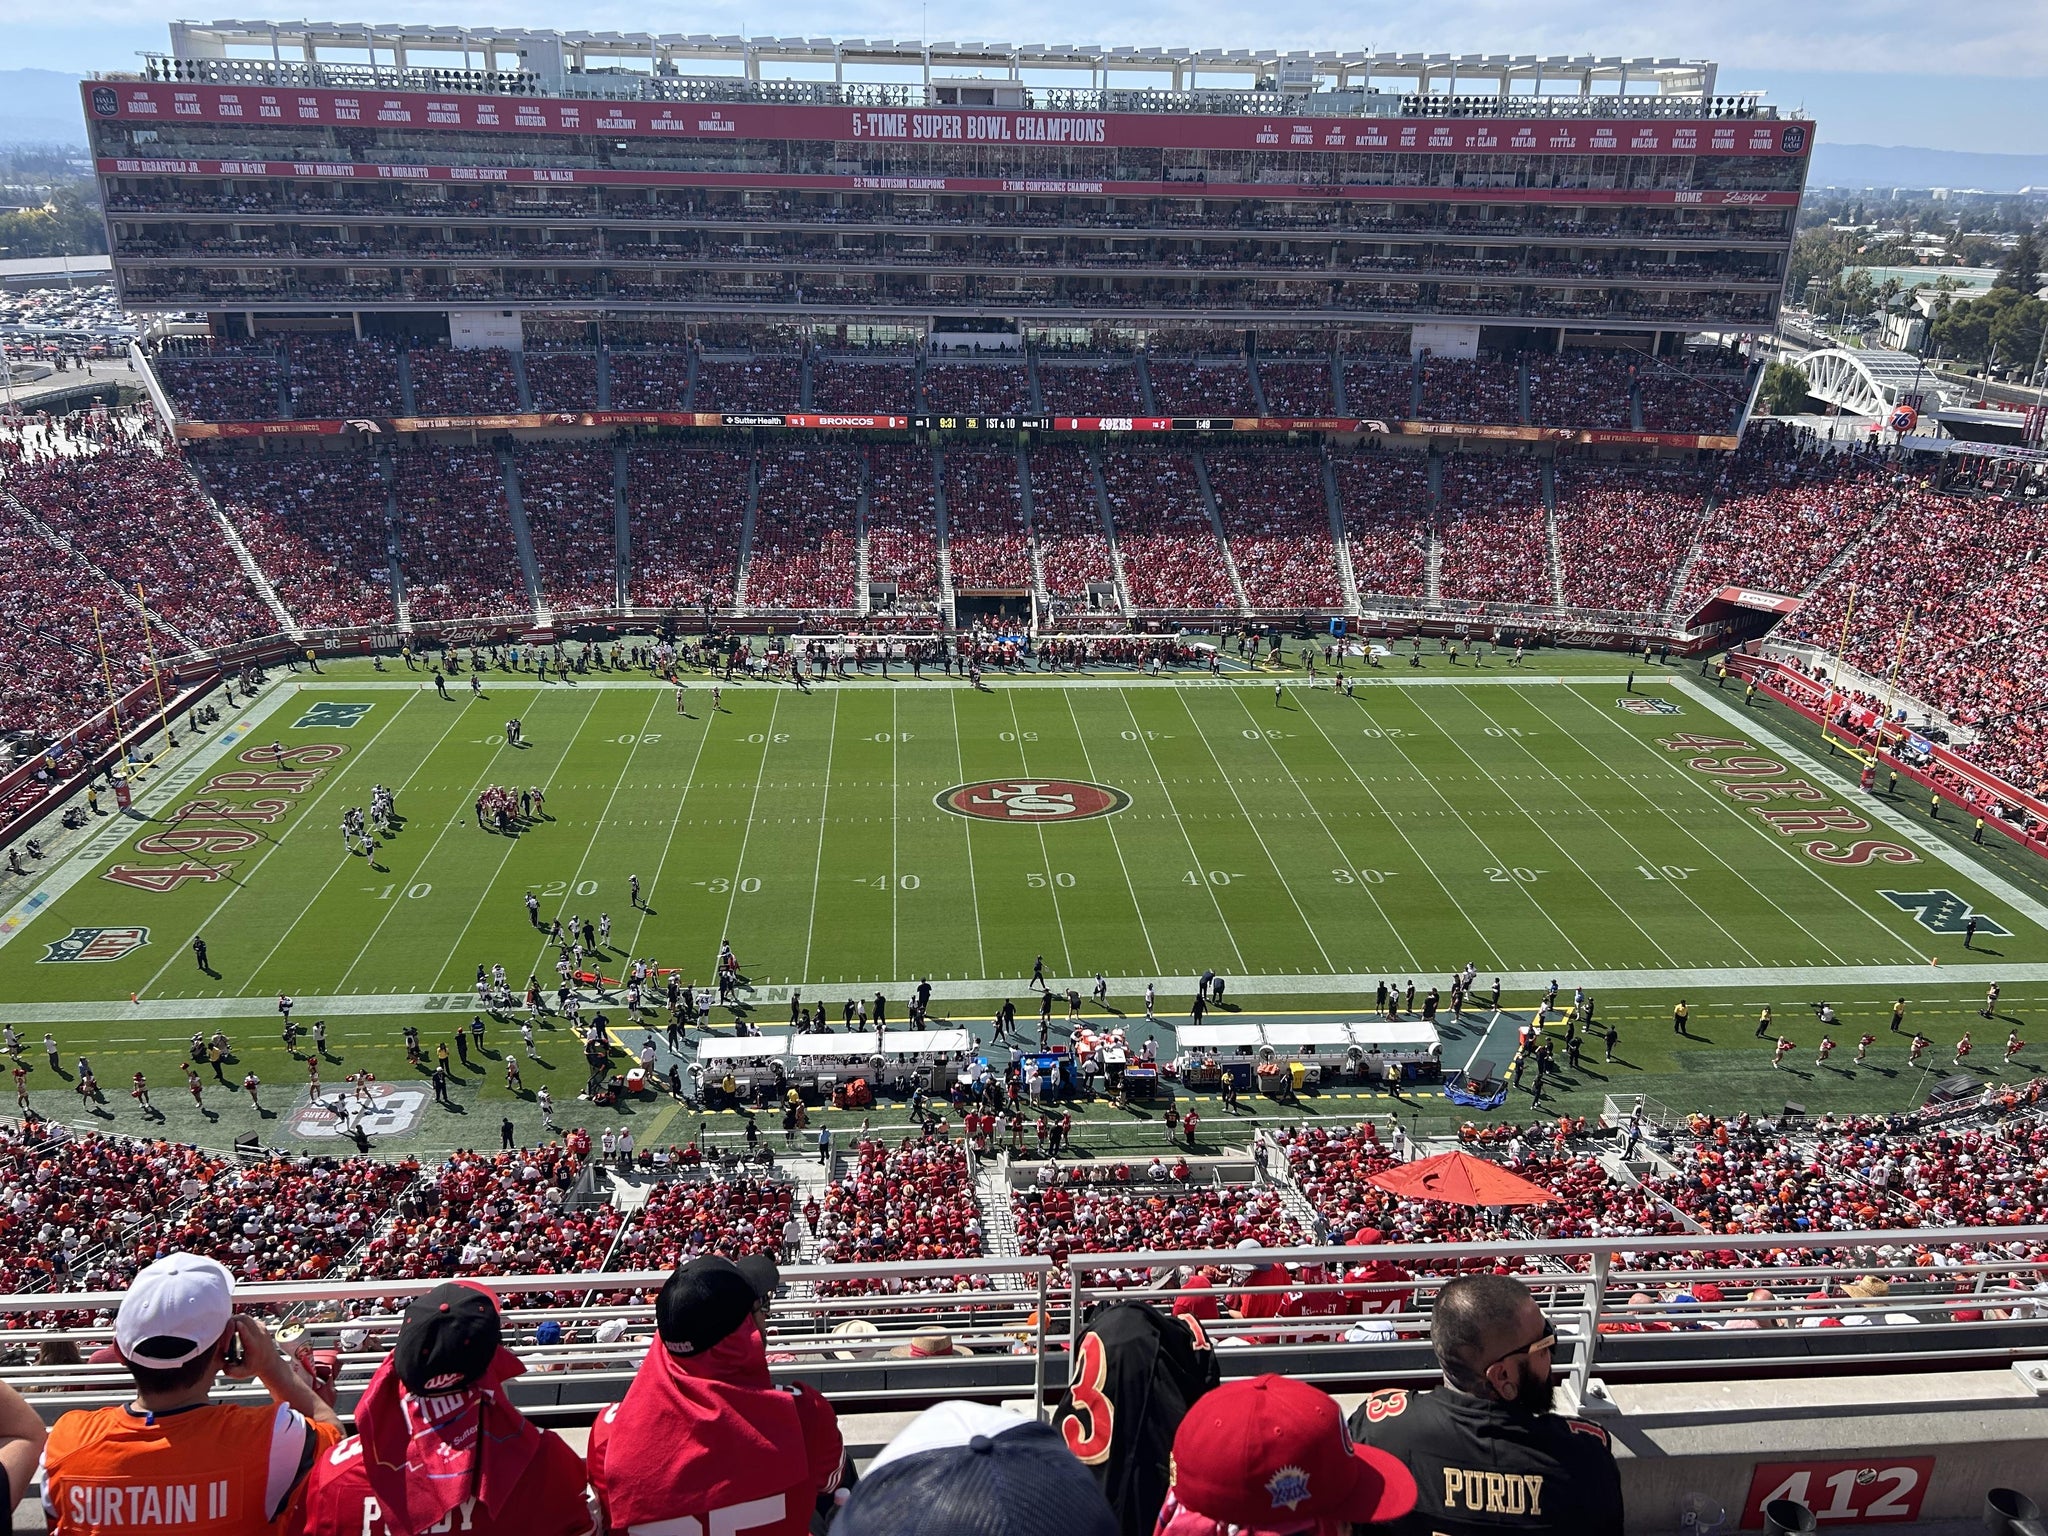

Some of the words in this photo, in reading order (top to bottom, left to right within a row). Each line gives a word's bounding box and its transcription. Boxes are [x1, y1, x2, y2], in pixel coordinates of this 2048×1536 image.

[262, 96, 277, 104] FRED
[298, 97, 316, 106] FRANK
[335, 98, 359, 107] CHARLES
[128, 102, 158, 113] BRODIE
[174, 104, 202, 115] CLARK
[219, 105, 243, 116] CRAIG
[260, 106, 281, 117] DEAN
[299, 107, 319, 118] GORE
[336, 108, 360, 120] HALEY
[377, 110, 411, 122] JOHNSON
[427, 112, 461, 124] JOHNSON
[662, 110, 672, 119] JOE
[711, 111, 721, 119] LEO
[476, 114, 500, 126] JONES
[515, 115, 546, 127] KRUEGER
[561, 117, 580, 128] LOTT
[597, 118, 637, 130] McELHENNY
[651, 119, 684, 131] MONTANA
[698, 121, 735, 132] NOMELLINI
[853, 113, 907, 138] 5-TIME
[913, 114, 962, 139] SUPER
[967, 116, 1011, 141] BOWL
[1015, 116, 1105, 142] CHAMPIONS
[1256, 133, 1279, 144] OWENS
[1675, 129, 1696, 137] PATRICK
[1714, 129, 1735, 138] BRYANT
[1753, 130, 1771, 138] STEVE
[1290, 134, 1313, 145] OWENS
[1325, 135, 1346, 146] PERRY
[1355, 135, 1388, 146] RATHMAN
[1400, 136, 1416, 146] RICE
[1428, 137, 1453, 147] SOLTAU
[1465, 137, 1476, 147] ST.
[1477, 137, 1498, 147] CLAIR
[1511, 137, 1537, 148] TAYLOR
[1549, 137, 1576, 148] TITTLE
[1589, 138, 1617, 149] TURNER
[1631, 138, 1659, 149] WILCOX
[1672, 138, 1697, 150] WILLIS
[1711, 139, 1735, 150] YOUNG
[1749, 139, 1773, 150] YOUNG
[116, 160, 140, 172] EDDIE
[188, 162, 201, 173] JR.
[219, 162, 240, 174] JOHN
[242, 163, 266, 174] McVAY
[293, 164, 314, 175] TONY
[316, 165, 355, 177] MORABITO
[378, 166, 391, 177] VIC
[392, 167, 429, 178] MORABITO
[451, 168, 478, 180] GEORGE
[479, 170, 508, 181] SEIFERT
[533, 171, 549, 181] BILL
[550, 171, 574, 182] WALSH
[853, 178, 880, 188] 22-TIME
[880, 178, 908, 189] DIVISION
[908, 179, 945, 190] CHAMPIONS
[1003, 181, 1025, 191] 8-TIME
[1025, 182, 1066, 192] CONFERENCE
[1066, 183, 1103, 193] CHAMPIONS
[1675, 192, 1702, 203] HOME
[1721, 192, 1768, 205] Faithful
[734, 416, 757, 424] Sutter
[757, 416, 782, 425] Health
[800, 417, 805, 426] 3
[819, 417, 874, 426] BRONCOS
[889, 417, 895, 428] 0
[940, 418, 956, 428] 9:31
[986, 418, 999, 428] 1ST
[1007, 418, 1015, 428] 10
[1040, 418, 1049, 428] 11
[1071, 418, 1078, 430] 0
[1098, 418, 1133, 431] 49ERS
[1160, 420, 1165, 429] 2
[1195, 420, 1211, 429] 1:49
[1892, 412, 1910, 428] 76
[263, 425, 289, 433] DENVER
[1556, 629, 1614, 647] Faithful
[748, 733, 790, 743] 30
[874, 732, 916, 742] 40
[999, 731, 1039, 743] 50
[1120, 730, 1164, 741] 40
[1242, 729, 1284, 740] 30
[1363, 728, 1407, 739] 20
[618, 734, 662, 745] 20
[148, 766, 205, 801] CATCH
[1655, 732, 1925, 866] 49ERS
[99, 743, 352, 893] 49ERS
[1181, 870, 1231, 886] 40
[1331, 868, 1385, 884] 30
[1483, 867, 1537, 882] 20
[1634, 865, 1688, 880] 10
[708, 877, 762, 893] 30
[870, 874, 920, 891] 40
[1026, 872, 1076, 888] 50
[374, 882, 432, 899] 10
[541, 880, 598, 897] 20
[1957, 1283, 1970, 1291] 314
[1062, 1331, 1114, 1466] 3
[454, 1425, 479, 1447] Sutter
[1443, 1466, 1543, 1516] PURDY
[1759, 1466, 1918, 1520] 412
[69, 1483, 198, 1527] SURTAIN
[208, 1480, 229, 1520] II
